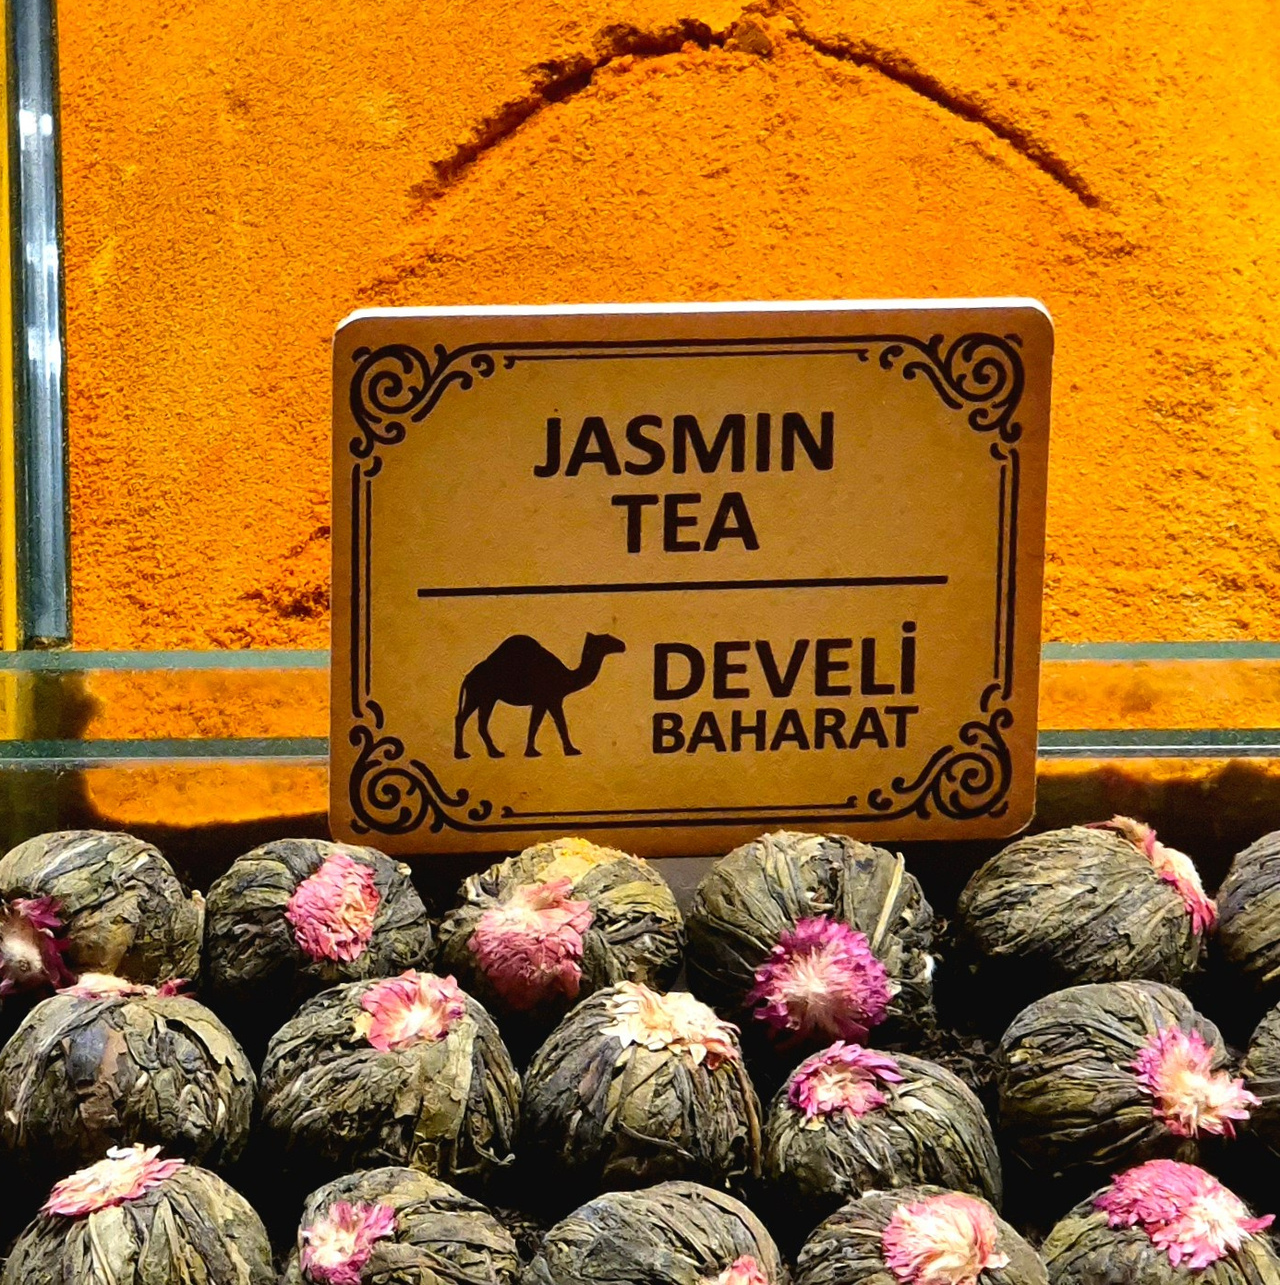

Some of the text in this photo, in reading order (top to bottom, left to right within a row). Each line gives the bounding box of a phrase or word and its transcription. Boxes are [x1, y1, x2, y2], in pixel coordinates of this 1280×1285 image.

[533, 409, 835, 477] JASMIN
[611, 491, 760, 554] TEA
[651, 705, 918, 754] BAHARAT
